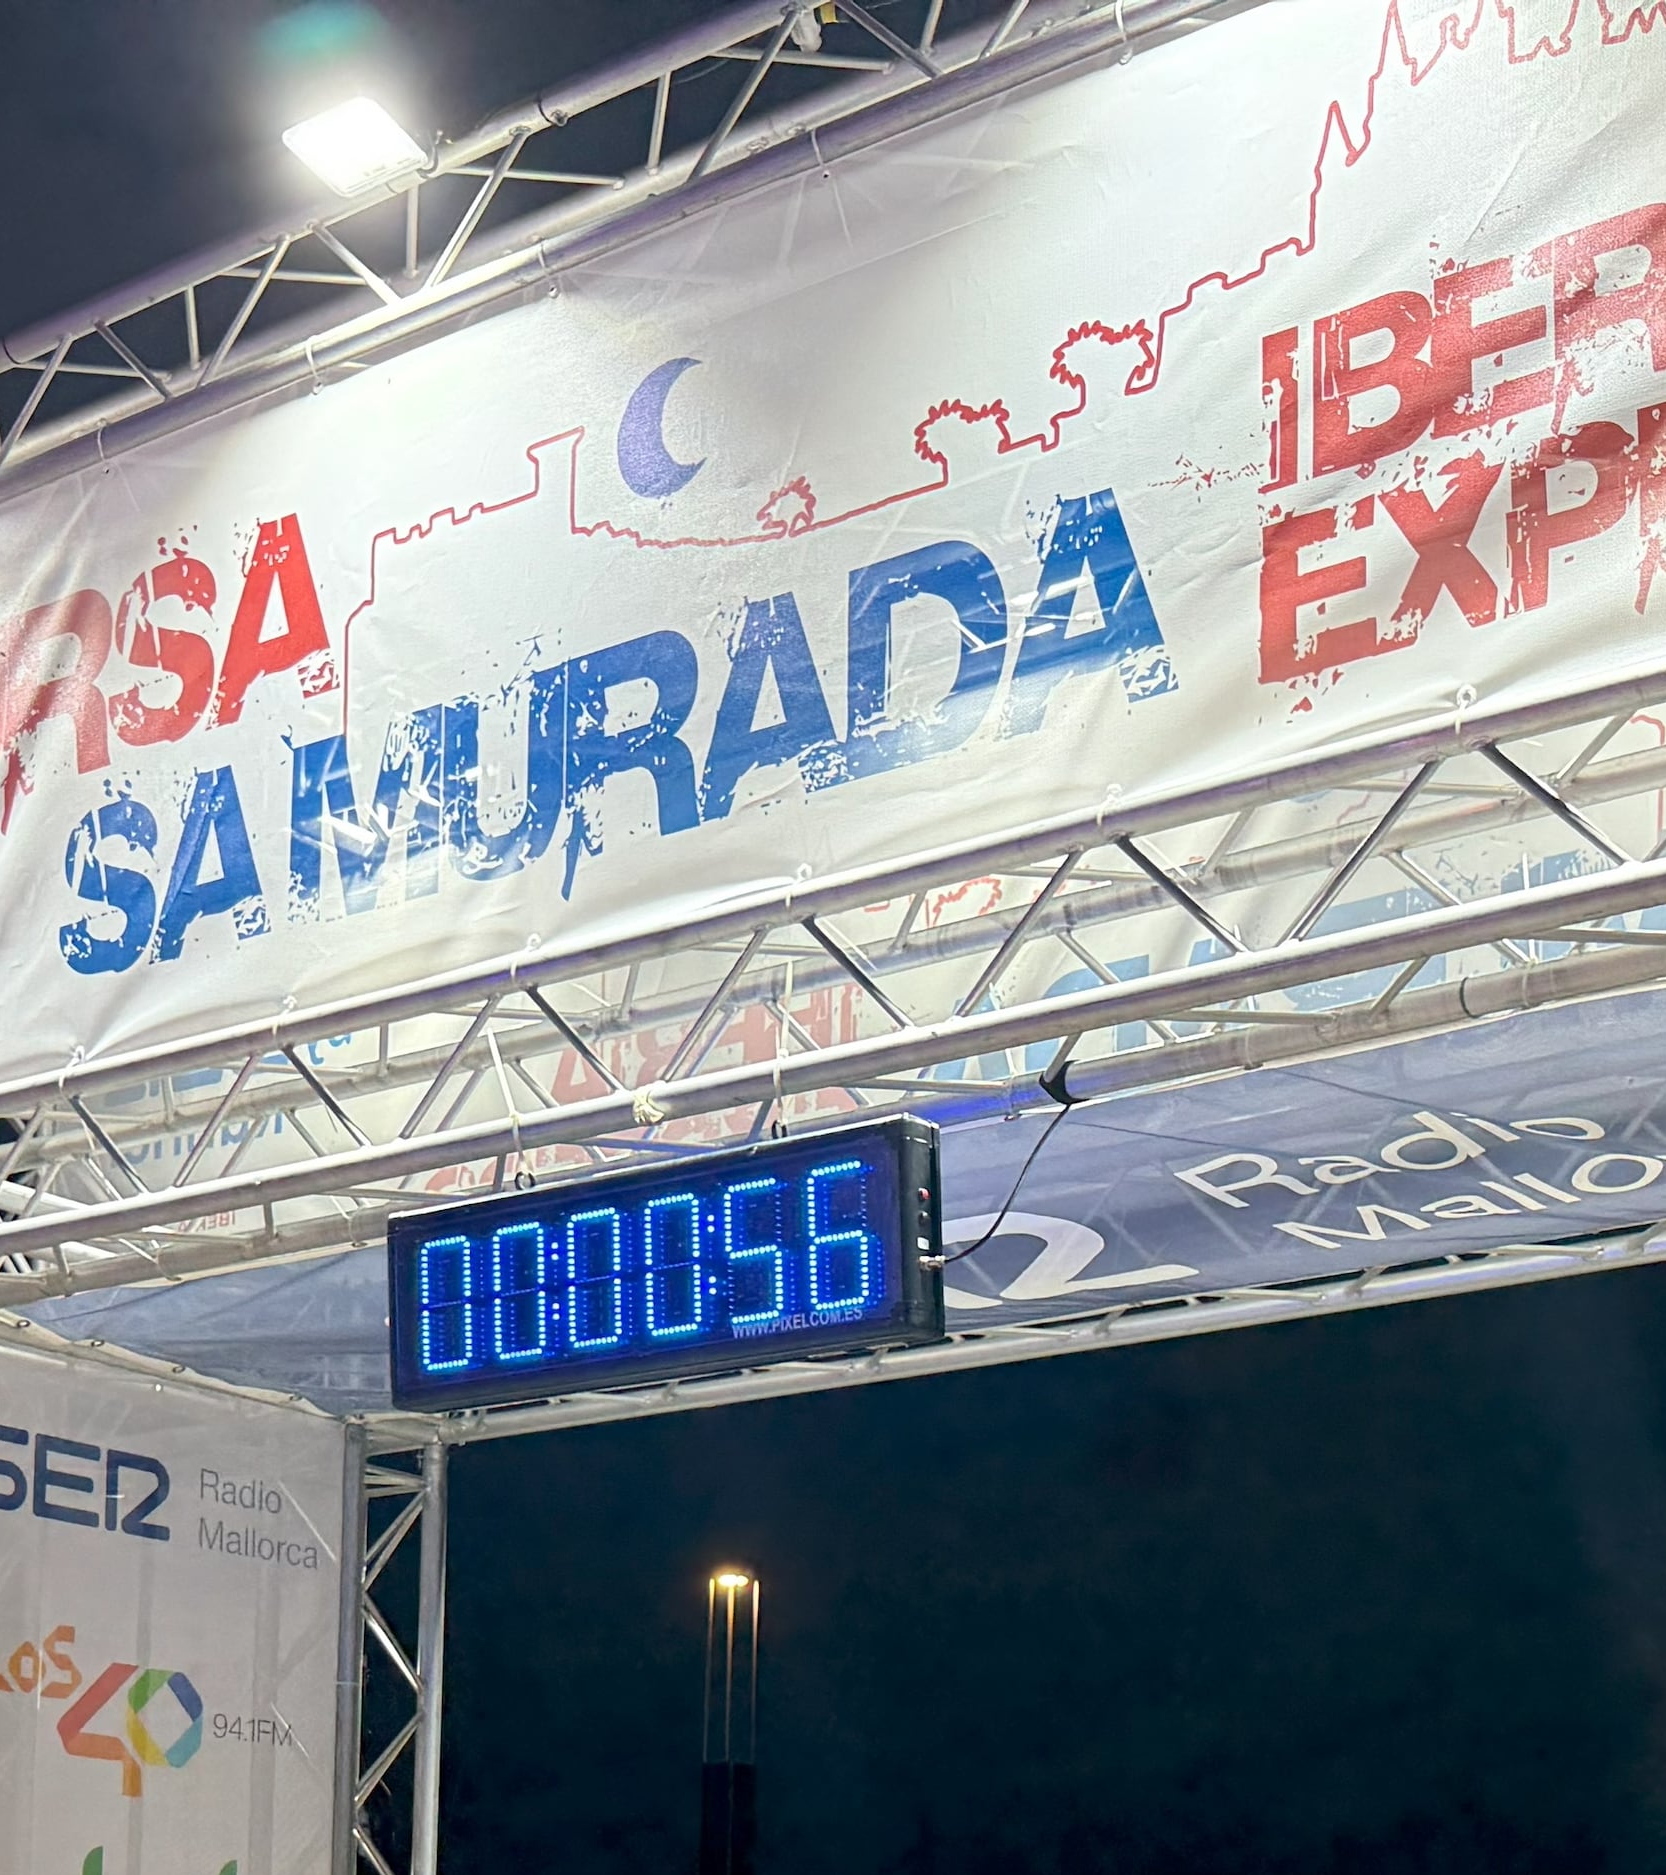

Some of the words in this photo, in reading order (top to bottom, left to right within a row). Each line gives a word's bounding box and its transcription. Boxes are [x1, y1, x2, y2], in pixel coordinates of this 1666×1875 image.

[1174, 1110, 1607, 1210] Radio
[420, 1160, 871, 1373] 00:00:56
[732, 1306, 863, 1339] WWW.PIXELCOM.ES
[200, 1468, 283, 1515] Radio
[198, 1517, 319, 1570] Mallorca
[212, 1713, 293, 1747] 94.1FM
